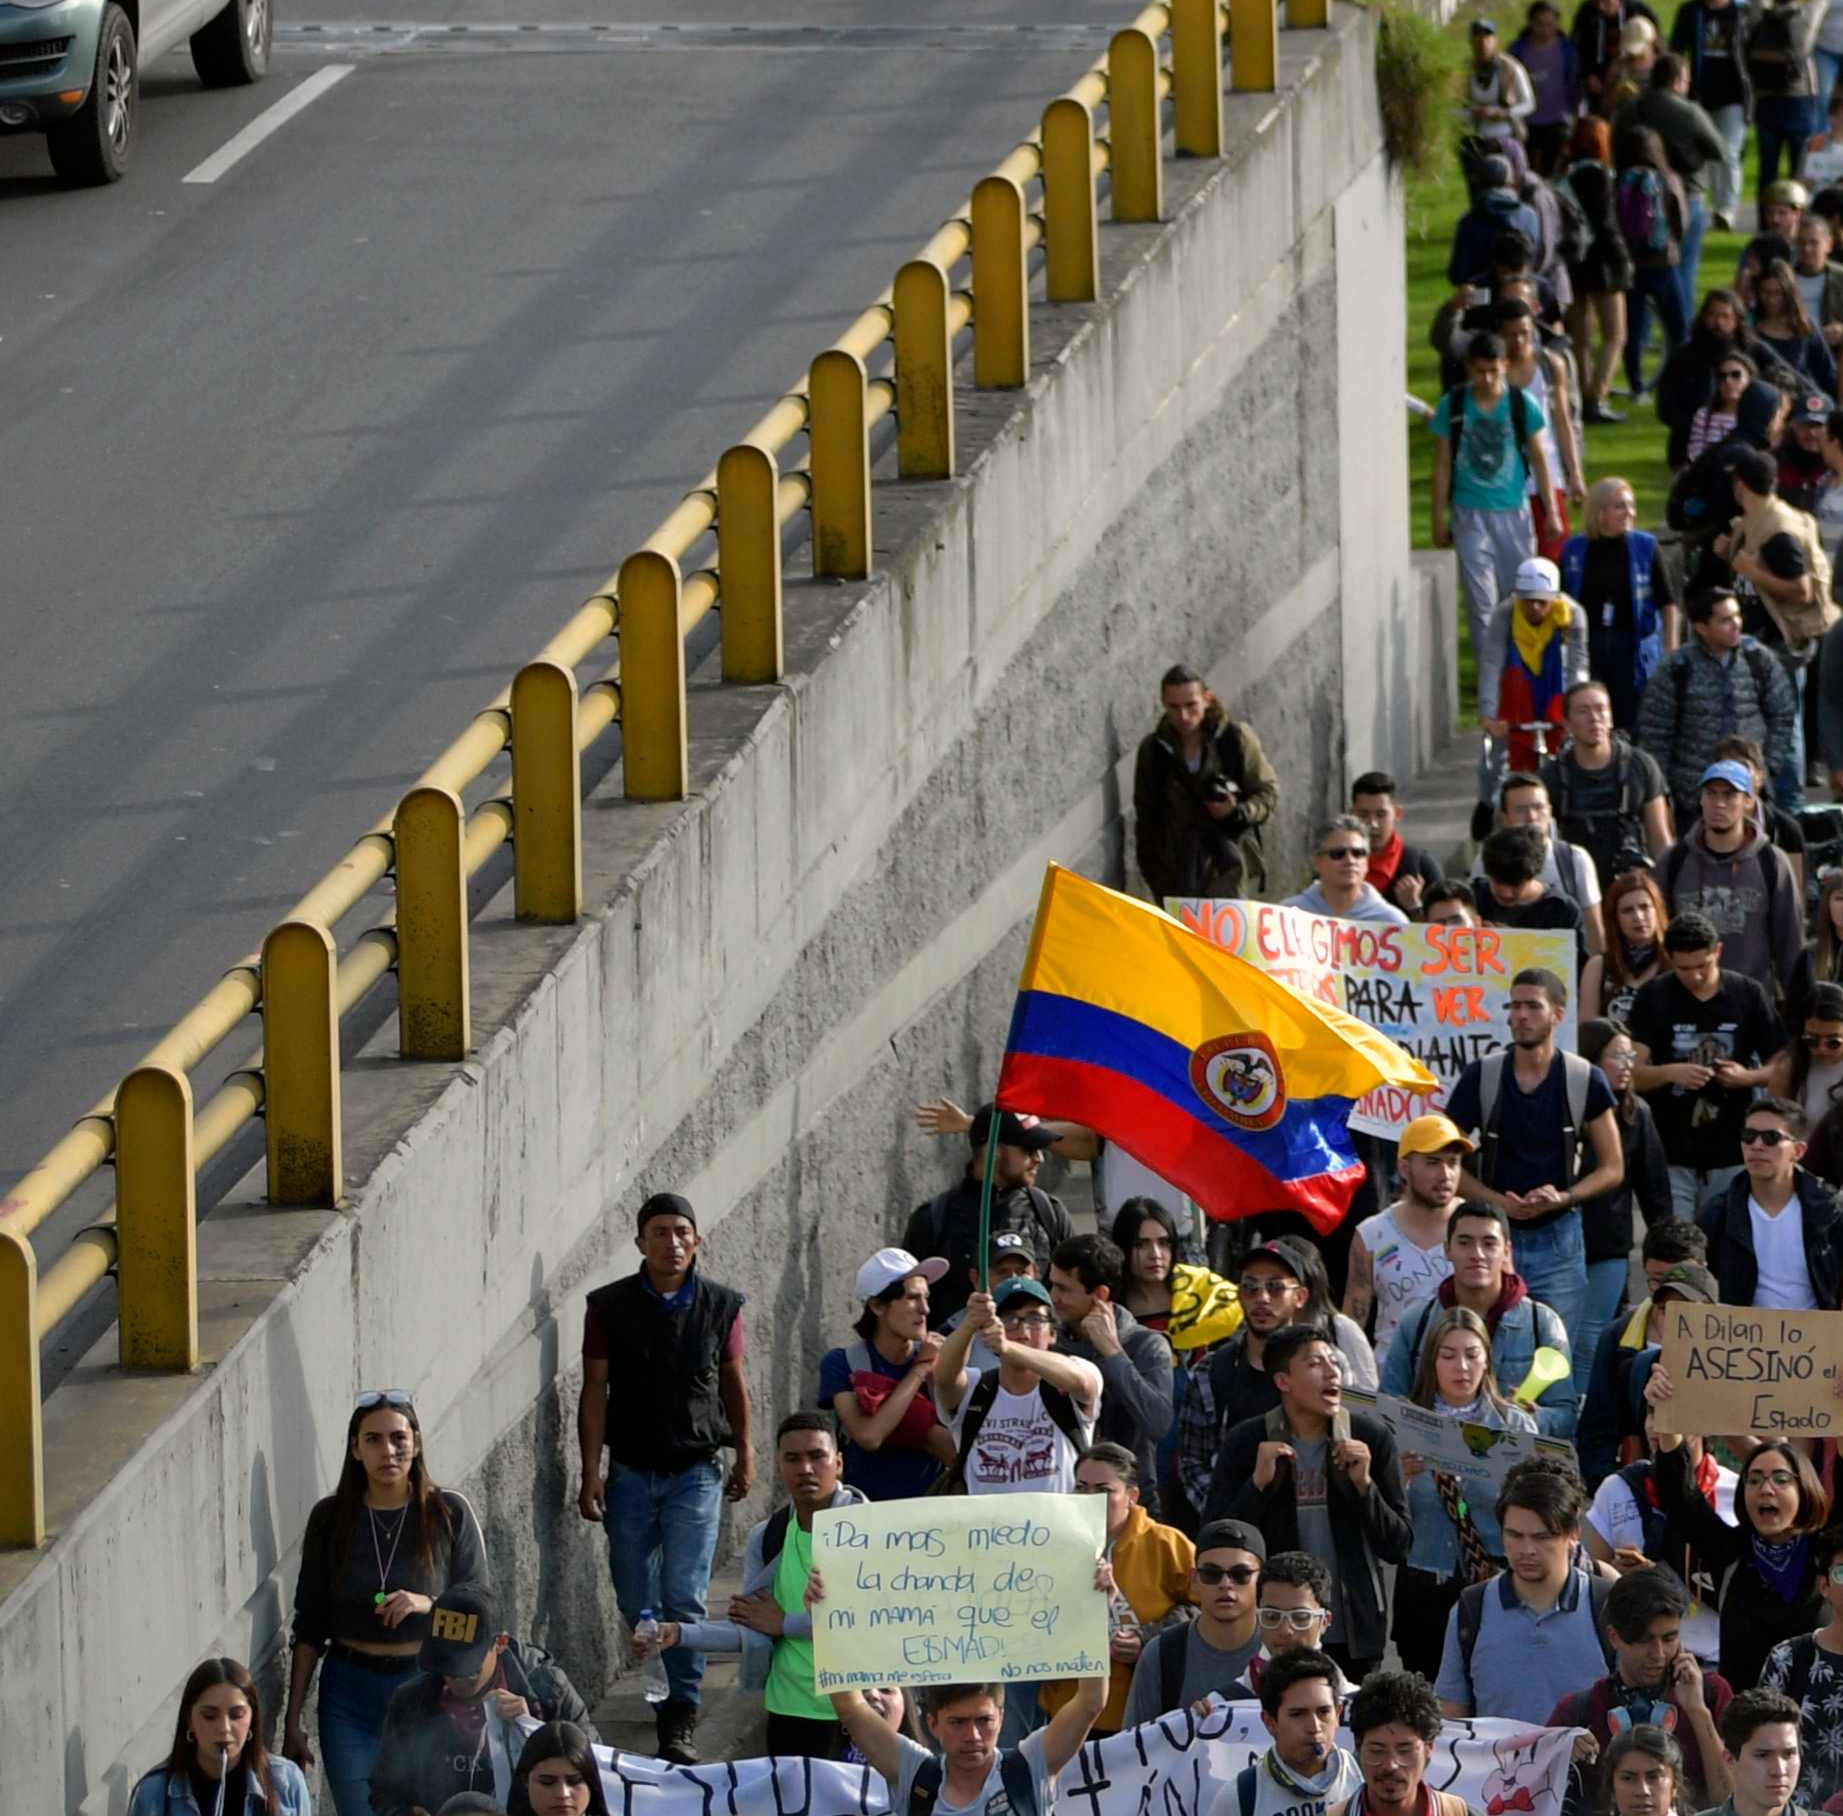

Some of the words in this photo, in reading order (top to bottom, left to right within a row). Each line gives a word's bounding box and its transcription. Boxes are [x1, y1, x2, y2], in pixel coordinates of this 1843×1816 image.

[1422, 925, 1505, 975] SER
[1344, 976, 1423, 1024] PARA
[1434, 987, 1490, 1026] VER
[1678, 1314, 1693, 1339] A
[1705, 1314, 1763, 1344] Dilan
[1780, 1320, 1802, 1344] lo
[1686, 1345, 1816, 1383] ASESINÓ
[1823, 1365, 1837, 1379] el
[1751, 1394, 1831, 1430] Estado
[968, 1520, 1050, 1550] miedo
[432, 1608, 478, 1643] FBI
[957, 1605, 1014, 1643] que
[1031, 1606, 1060, 1635] el
[1026, 1660, 1052, 1675] nos
